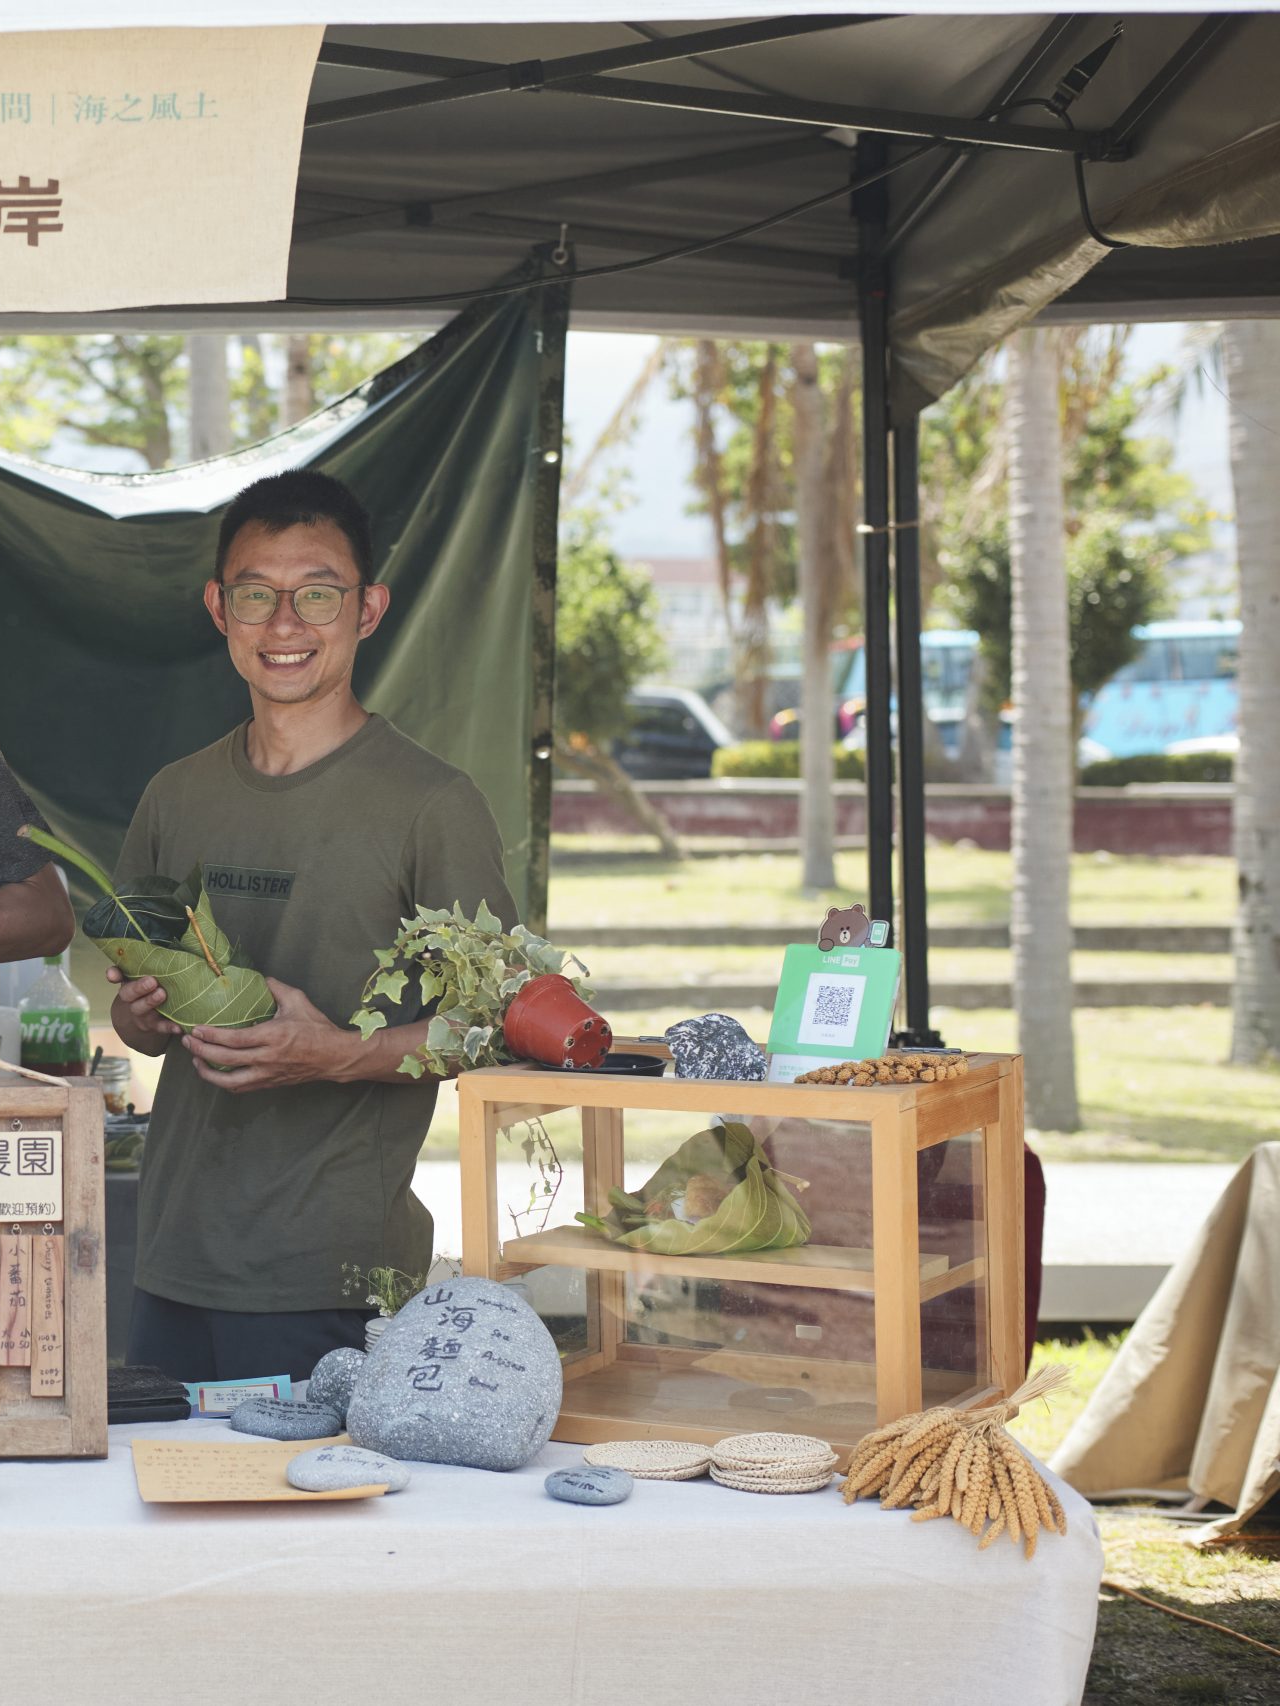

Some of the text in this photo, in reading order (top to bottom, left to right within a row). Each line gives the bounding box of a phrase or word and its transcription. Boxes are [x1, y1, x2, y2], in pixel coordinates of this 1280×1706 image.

[74, 92, 218, 123] 海之風土
[207, 871, 291, 893] HOLLISTER
[822, 955, 841, 964] LINE
[491, 1329, 510, 1341] Sea
